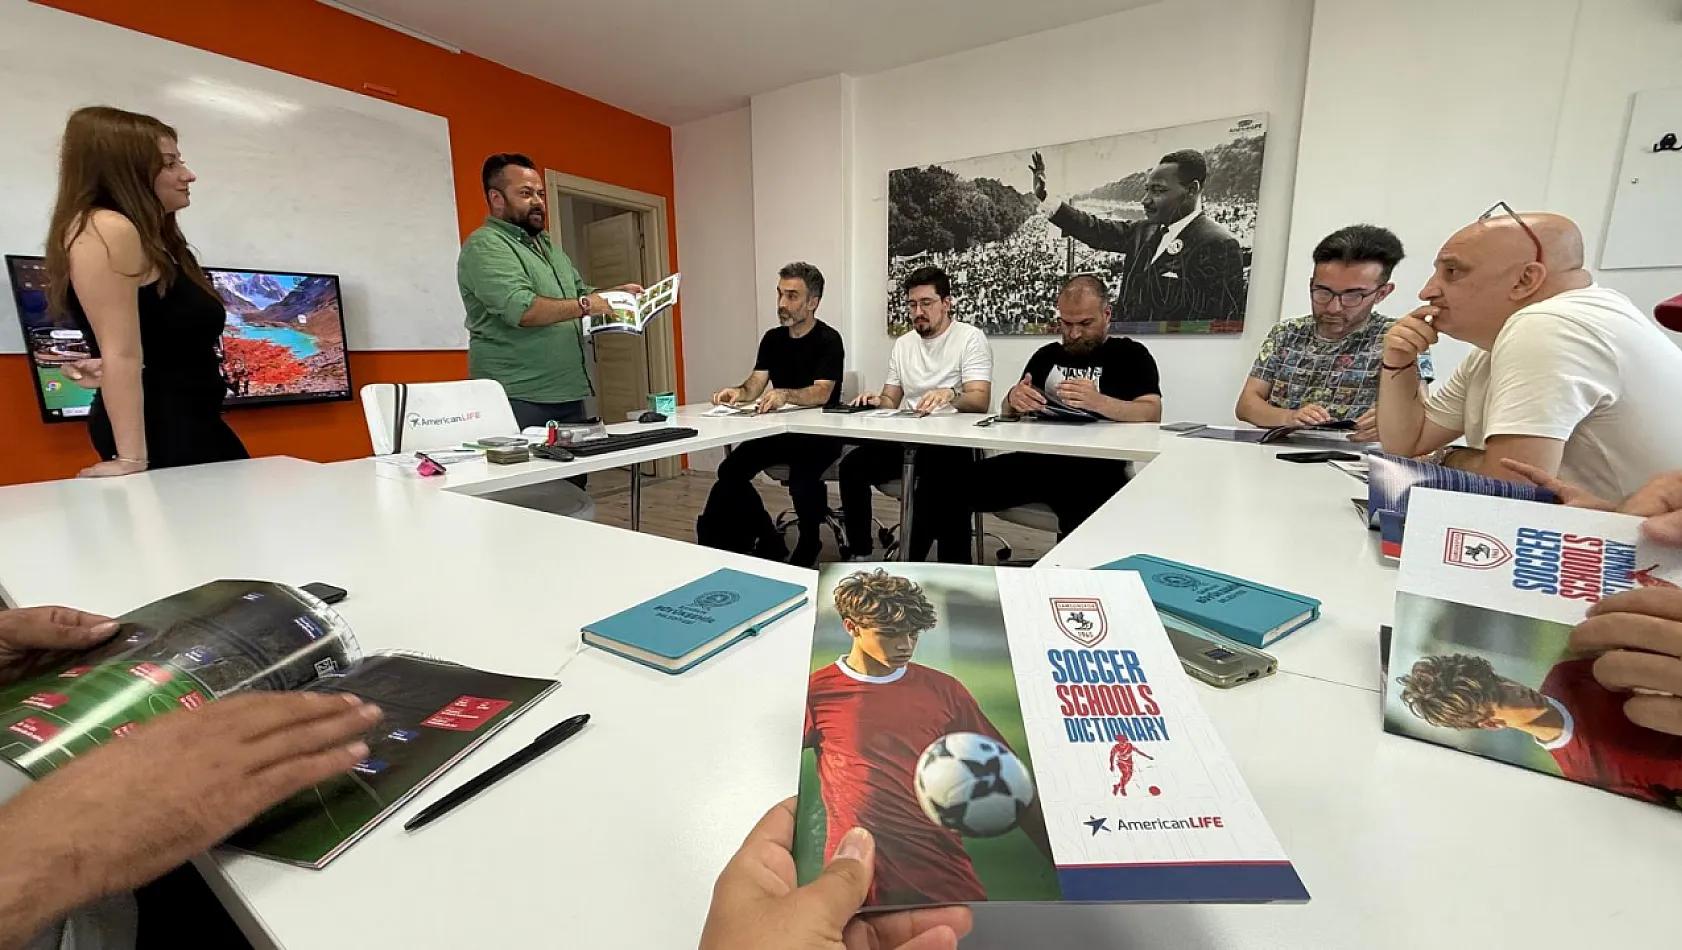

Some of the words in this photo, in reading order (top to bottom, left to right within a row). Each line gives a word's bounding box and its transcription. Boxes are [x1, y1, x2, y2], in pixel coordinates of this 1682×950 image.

[1512, 528, 1562, 595] SOCCER
[1559, 533, 1603, 603] SCHOOLS
[1047, 649, 1147, 684] SOCCER
[1055, 684, 1161, 716] SCHOOLS
[1063, 717, 1170, 743] DICTIONARY
[1118, 816, 1224, 831] AmericanLIFE
